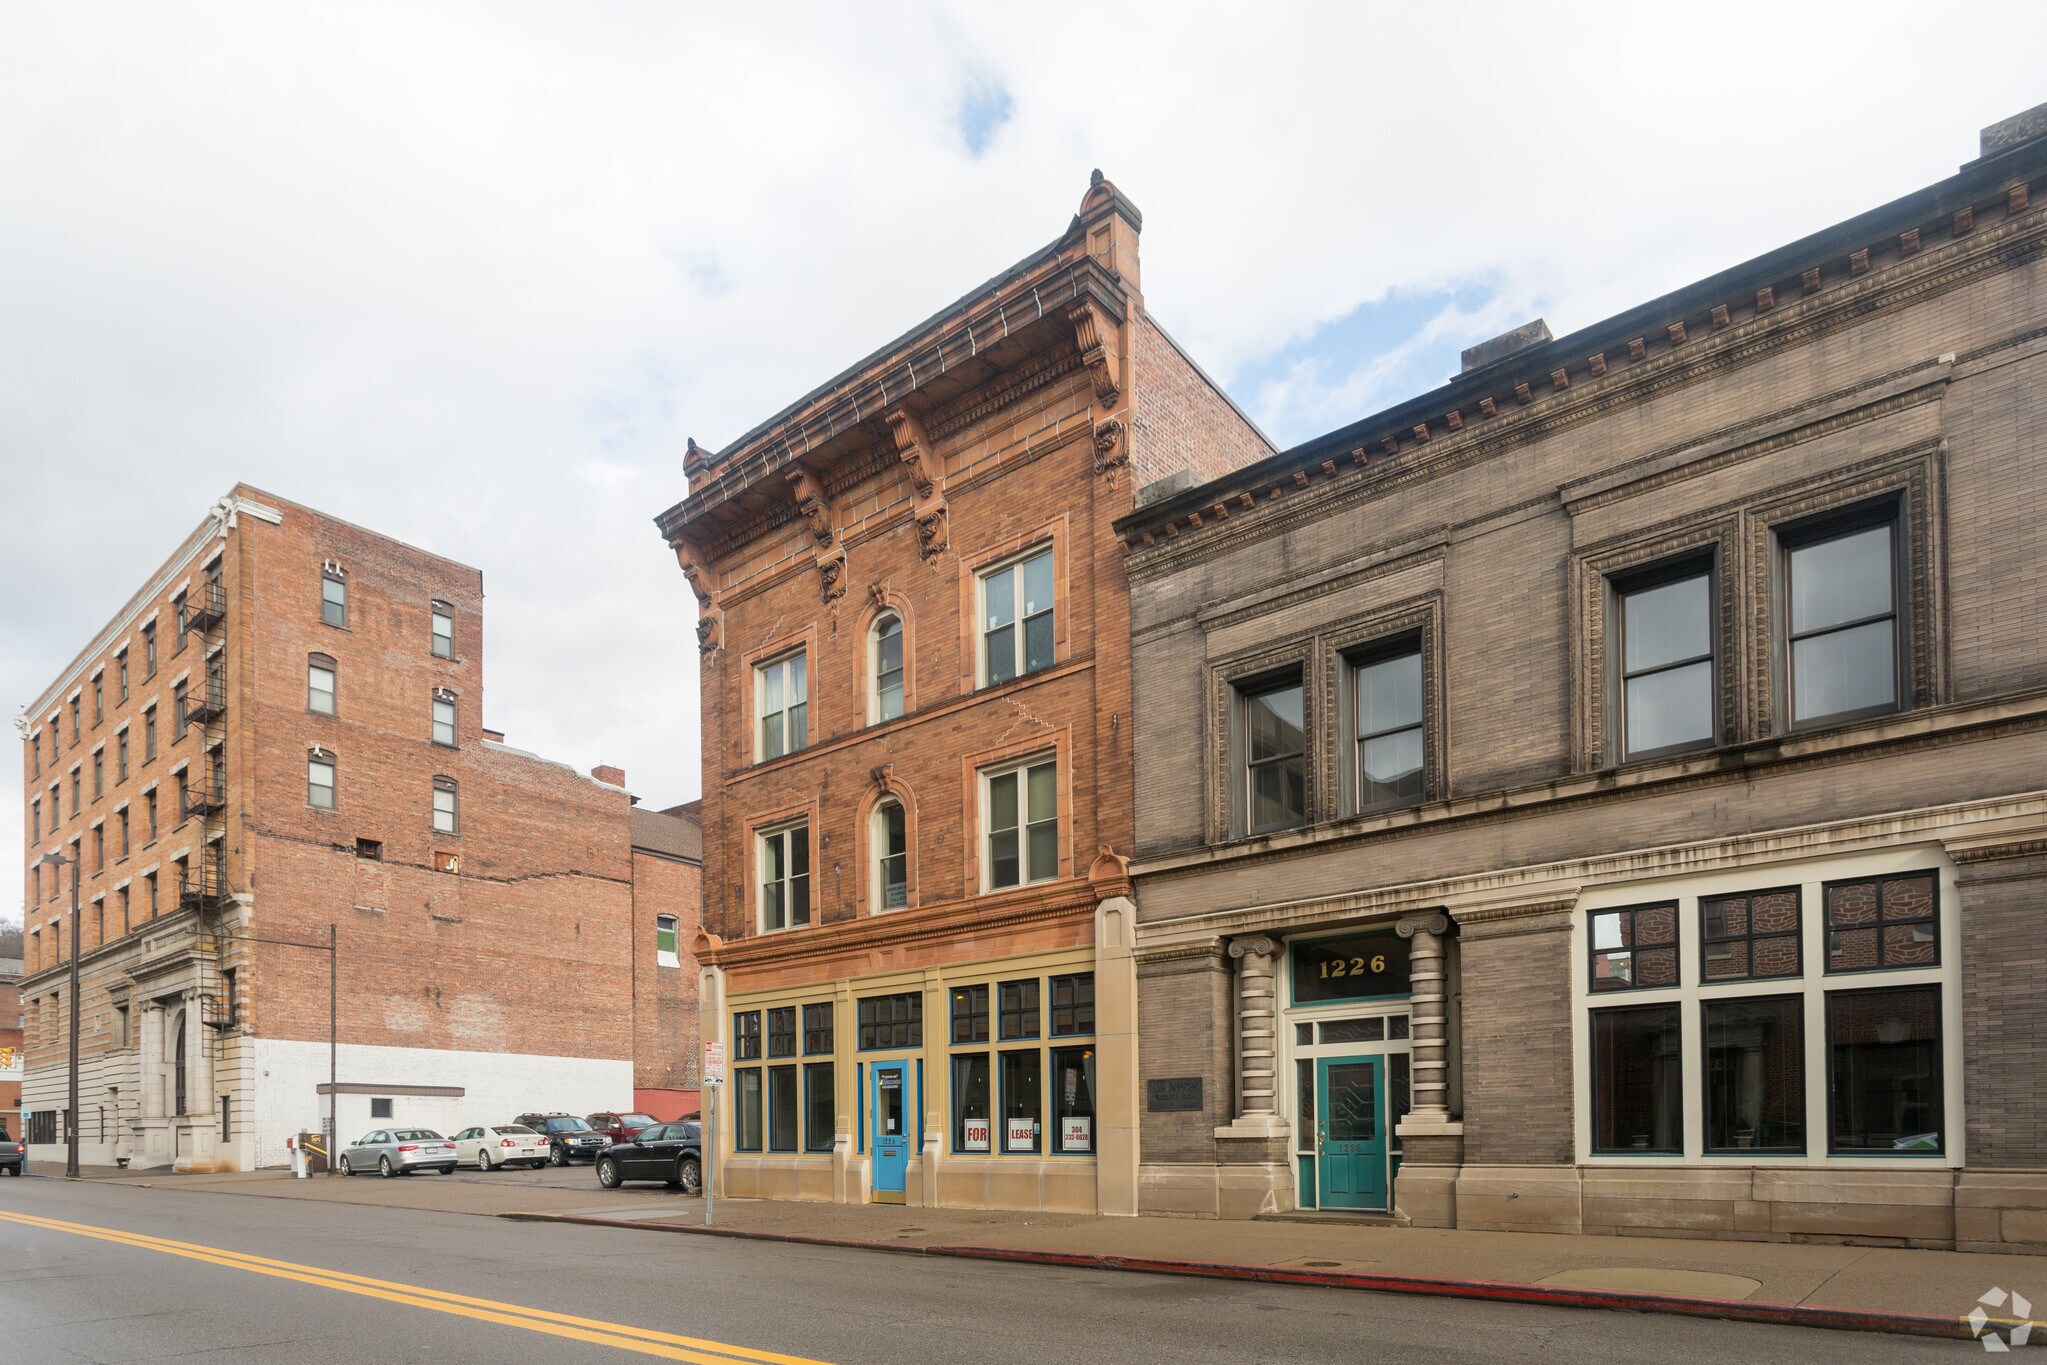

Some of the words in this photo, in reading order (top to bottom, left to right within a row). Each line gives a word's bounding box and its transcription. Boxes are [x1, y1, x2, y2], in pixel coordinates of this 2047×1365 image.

[1319, 954, 1386, 979] 1226
[967, 1127, 987, 1142] FOR
[1011, 1128, 1033, 1140] LEASE
[1071, 1125, 1083, 1134] 304
[1065, 1133, 1089, 1141] 232-0028
